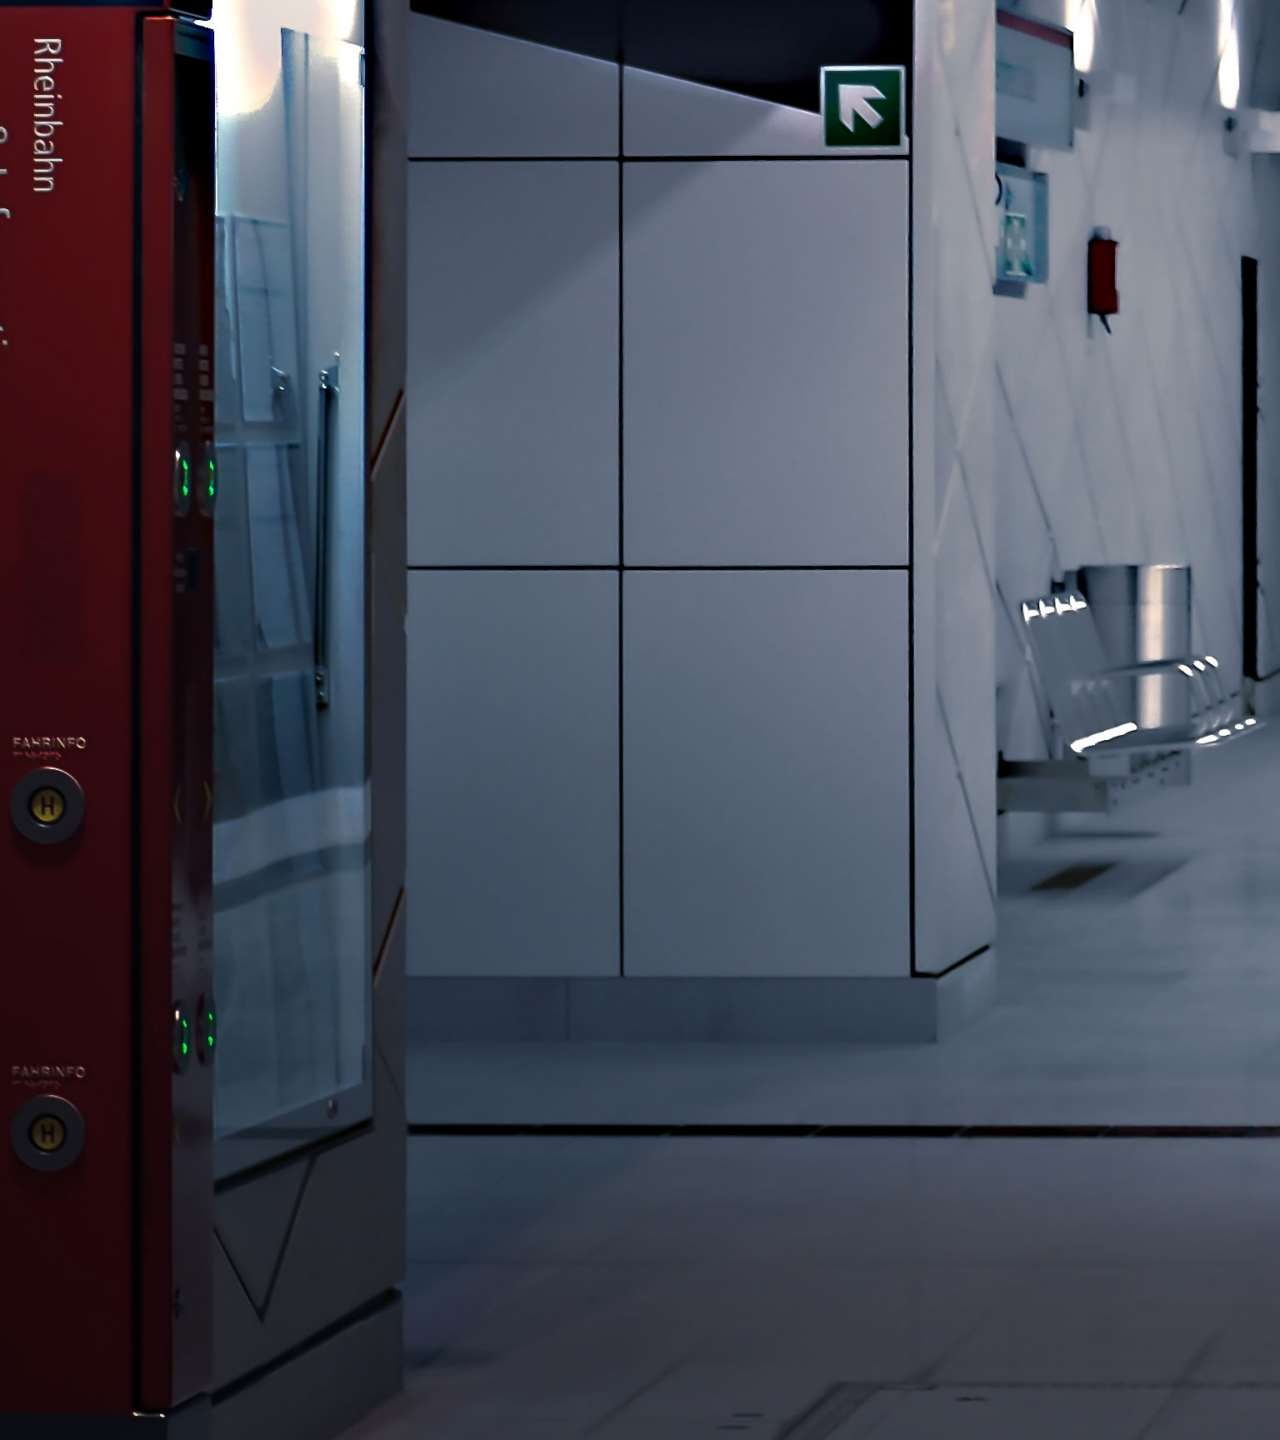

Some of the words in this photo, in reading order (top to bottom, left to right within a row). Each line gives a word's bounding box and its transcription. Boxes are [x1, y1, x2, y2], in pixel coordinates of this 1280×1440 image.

[32, 38, 64, 192] Rheinbahn
[12, 736, 87, 750] FAHRINFO
[41, 796, 54, 815] H
[42, 1124, 55, 1143] H
